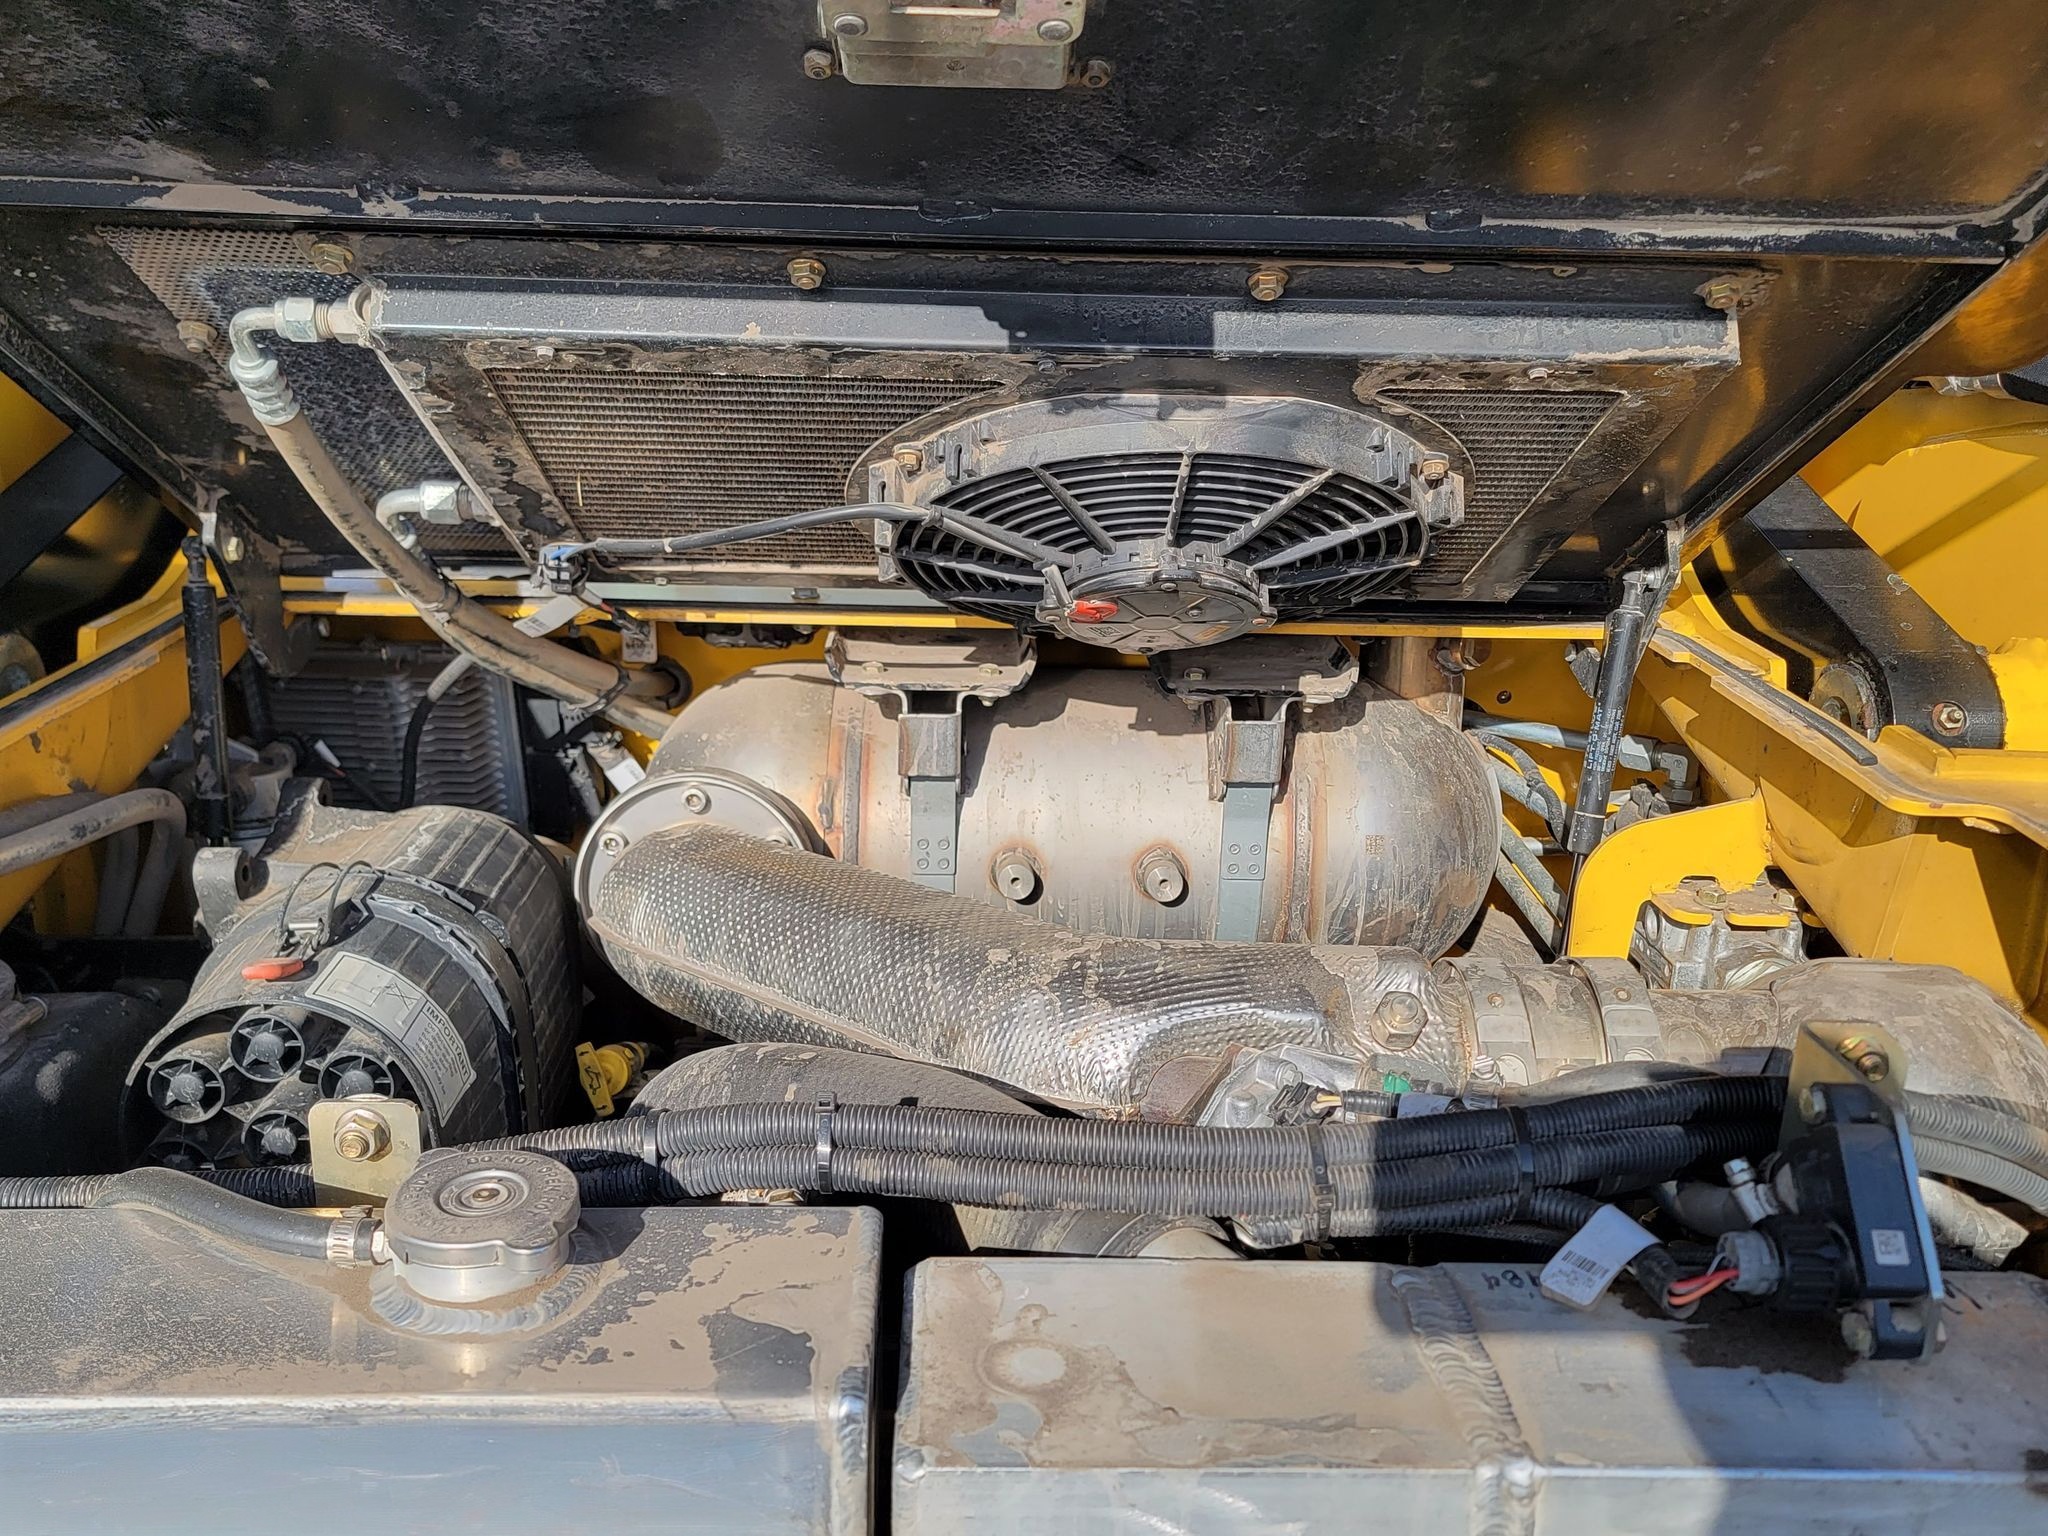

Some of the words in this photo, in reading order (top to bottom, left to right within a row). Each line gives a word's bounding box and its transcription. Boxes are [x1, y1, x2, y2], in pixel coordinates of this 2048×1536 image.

[426, 1006, 469, 1077] IMPORTANT
[466, 1155, 493, 1165] DO
[501, 1155, 539, 1167] NOT
[537, 1166, 563, 1195] OPEN
[526, 1197, 557, 1217] HOT
